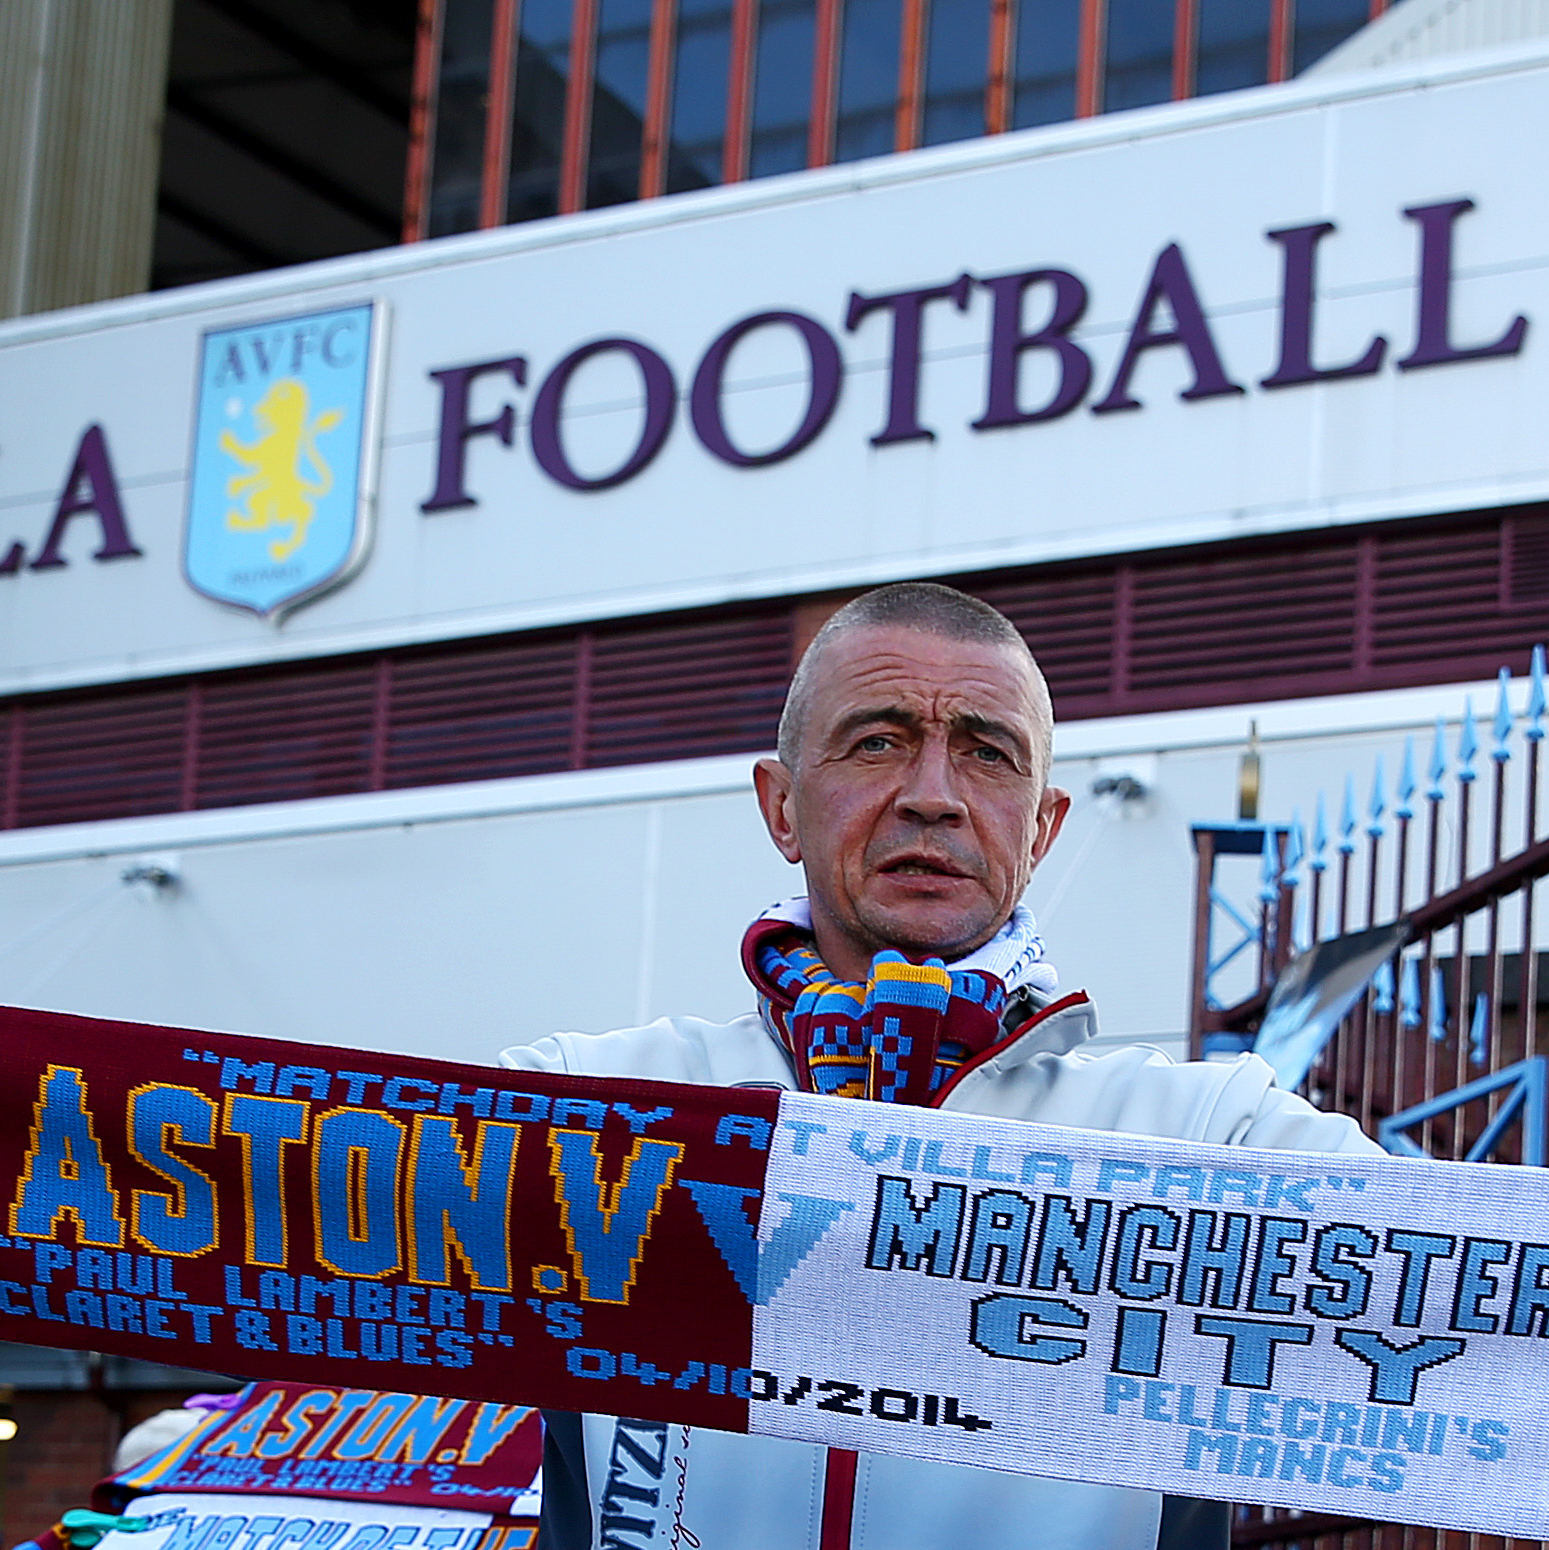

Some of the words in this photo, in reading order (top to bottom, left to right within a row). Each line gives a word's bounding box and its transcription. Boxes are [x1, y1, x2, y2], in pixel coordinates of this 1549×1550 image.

[214, 317, 359, 388] AVFC
[419, 197, 1529, 513] FOOTBALL
[8, 1063, 686, 1305] ASTON.V
[715, 1114, 828, 1157] AT
[849, 1130, 1075, 1188] VILLA
[235, 1309, 278, 1351] &
[968, 1292, 1466, 1407] CITY
[200, 1388, 540, 1466] ASTON.V
[565, 1347, 993, 1432] 04/10/2014
[1104, 1374, 1510, 1462] PELLEGRINI'S
[1184, 1428, 1408, 1491] MANCS
